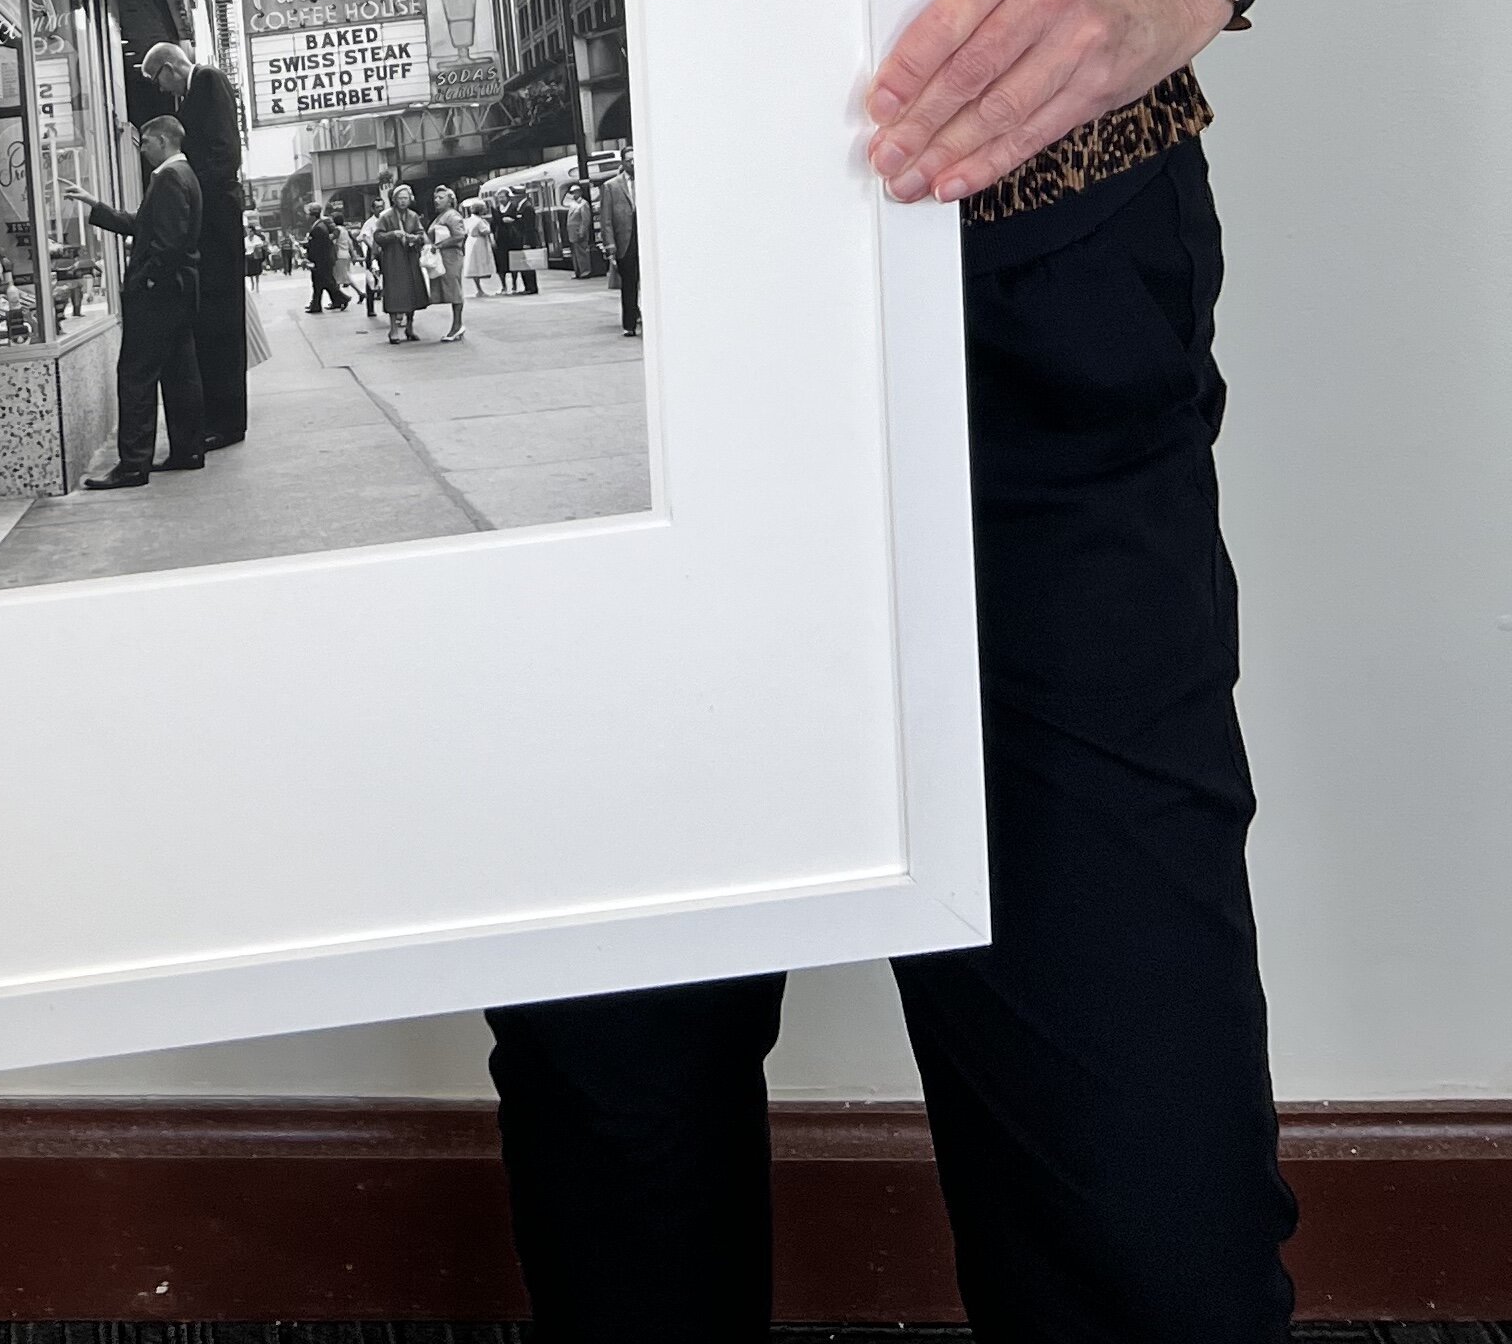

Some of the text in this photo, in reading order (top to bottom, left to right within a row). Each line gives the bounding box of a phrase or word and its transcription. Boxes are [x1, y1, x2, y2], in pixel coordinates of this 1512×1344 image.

[250, 3, 337, 31] COFFEE
[306, 27, 378, 50] BAKED
[269, 43, 411, 74] SWISS STEAK
[271, 62, 413, 94] POTATO PUFF
[437, 66, 497, 86] SODAS
[271, 85, 385, 114] & SHERBET
